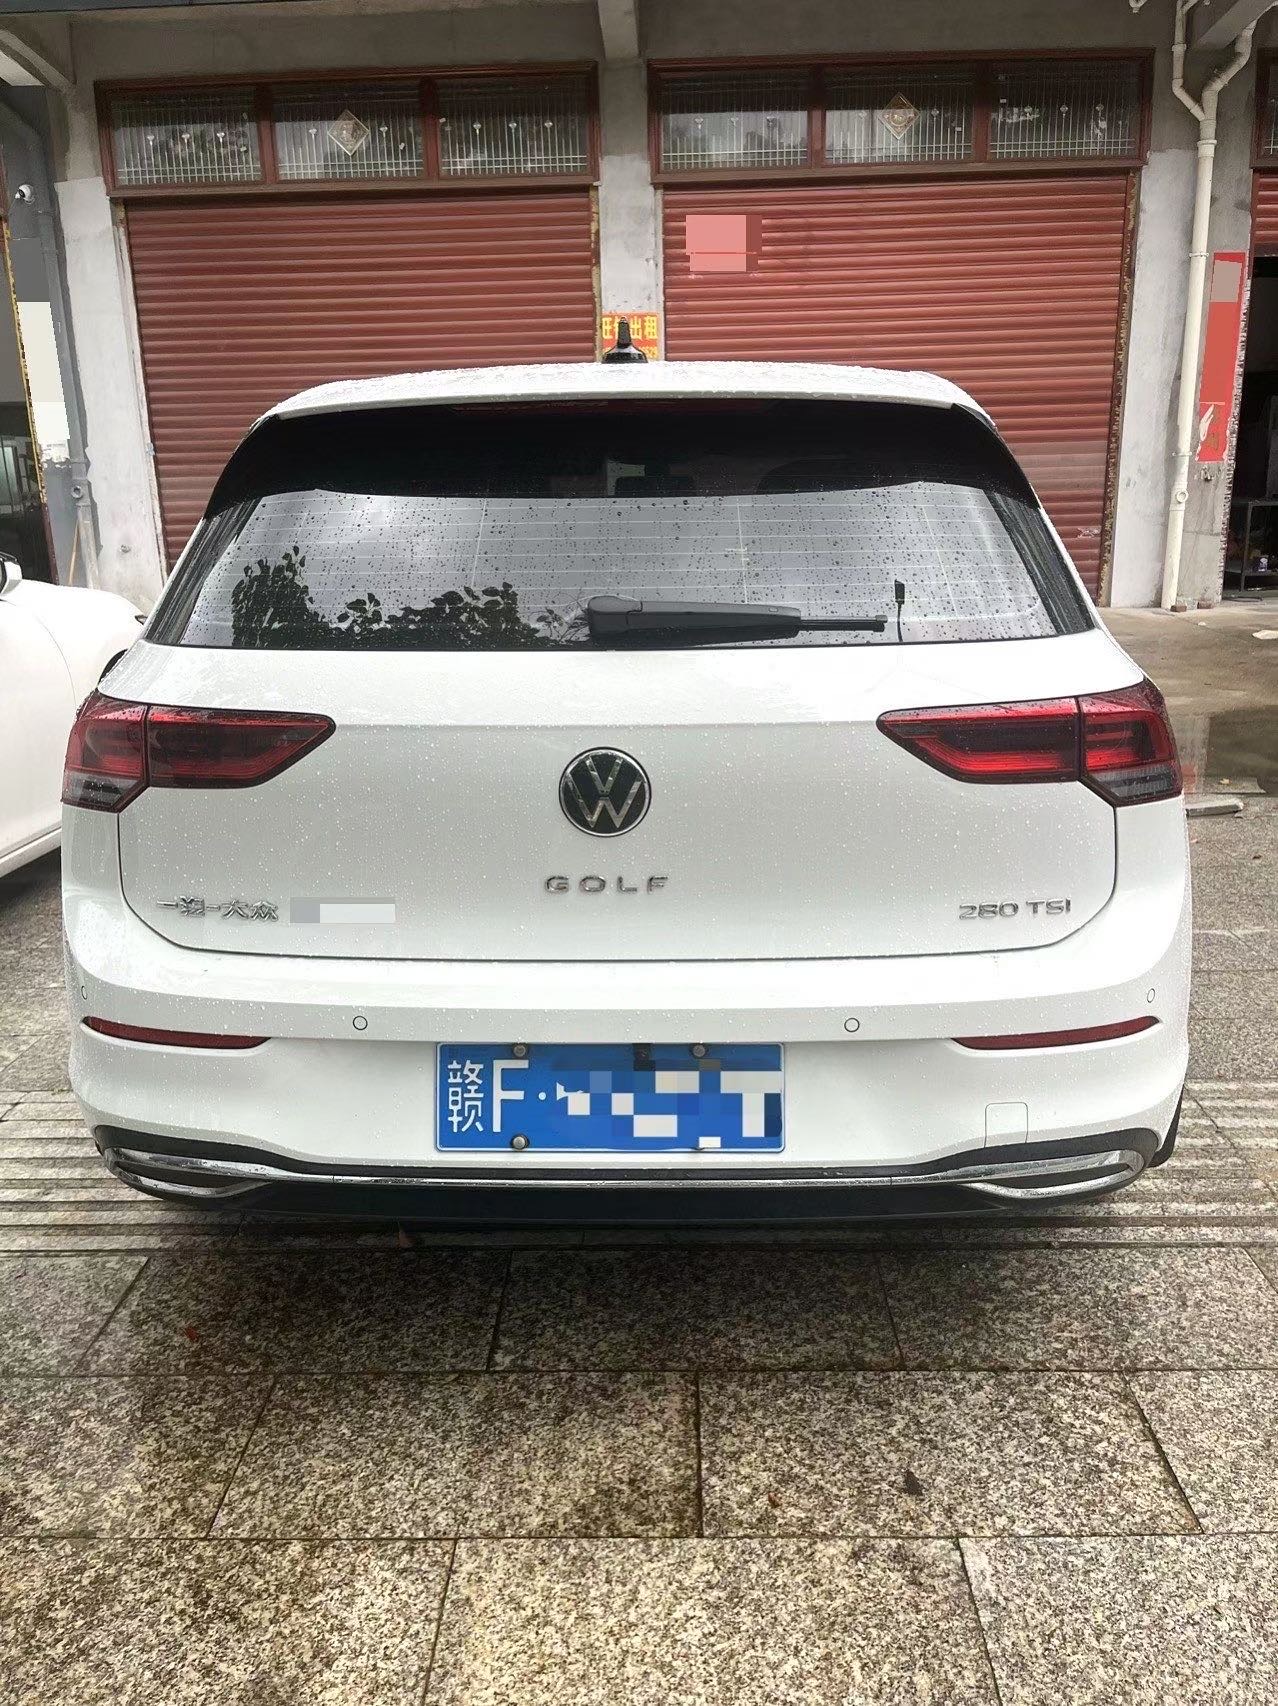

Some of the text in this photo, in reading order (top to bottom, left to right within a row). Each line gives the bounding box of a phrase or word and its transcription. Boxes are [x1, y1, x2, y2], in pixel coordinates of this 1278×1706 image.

[545, 876, 668, 893] GOLF
[959, 898, 1071, 920] 280 TSI
